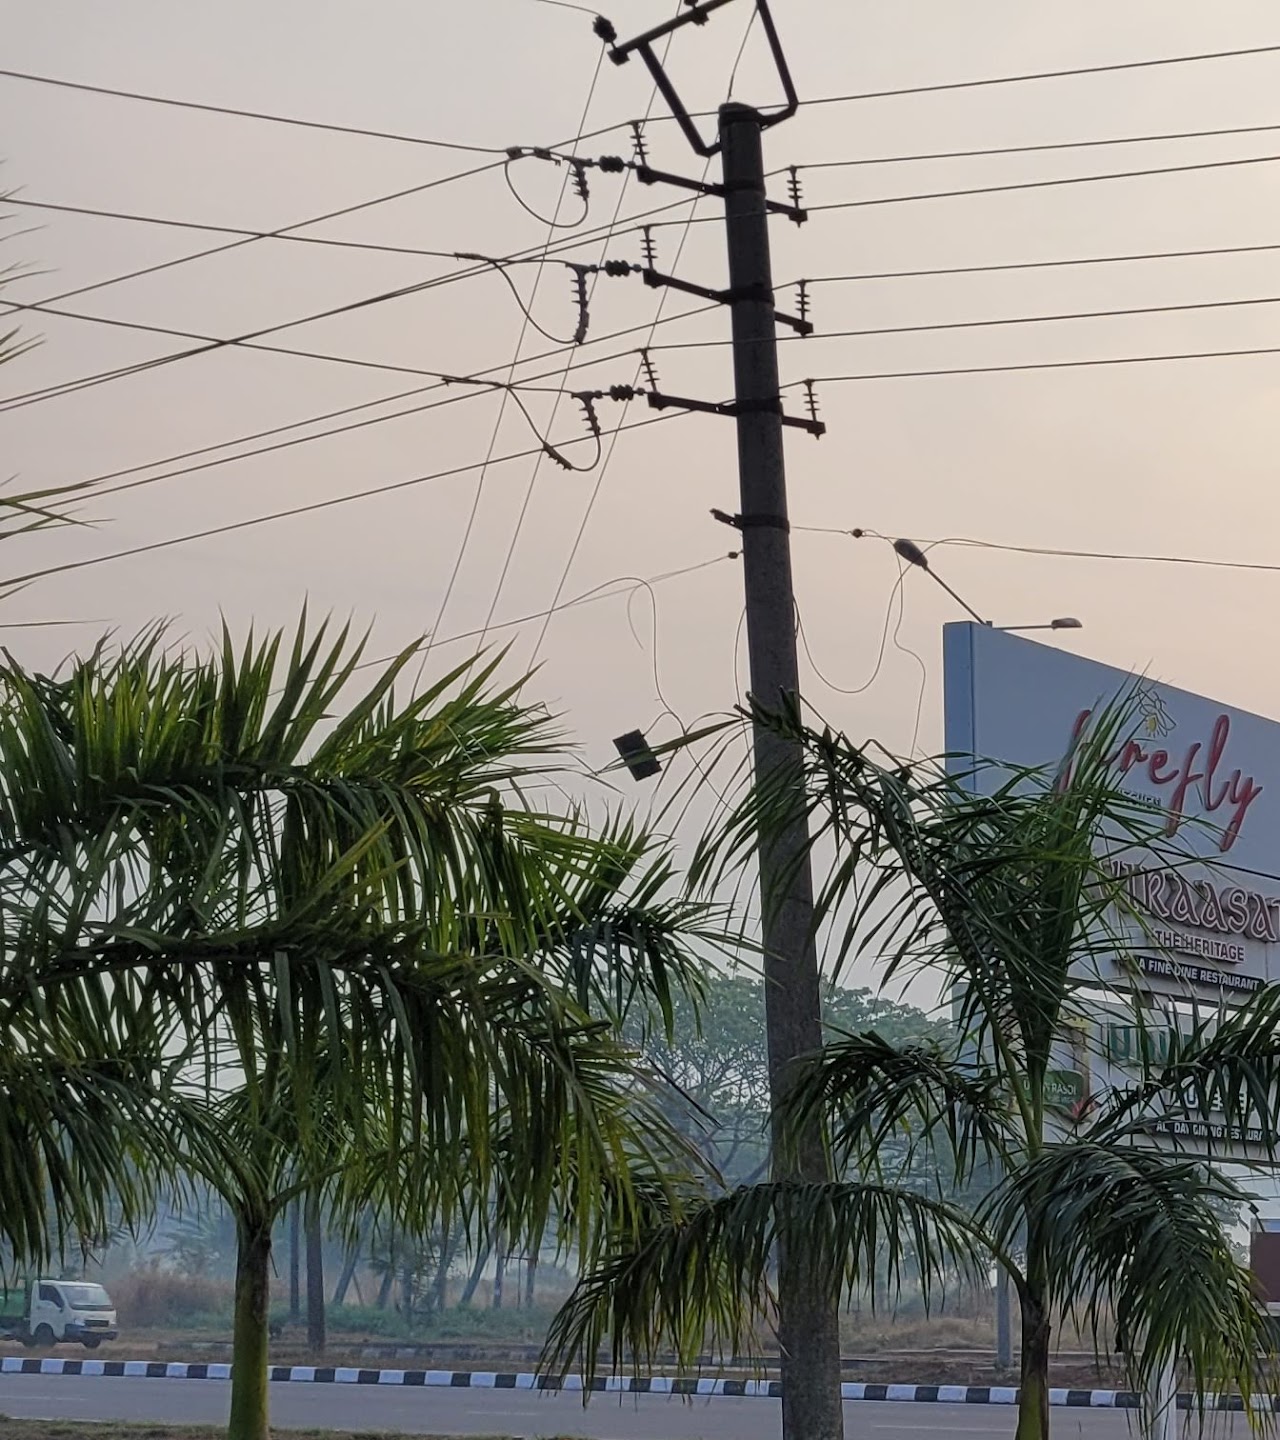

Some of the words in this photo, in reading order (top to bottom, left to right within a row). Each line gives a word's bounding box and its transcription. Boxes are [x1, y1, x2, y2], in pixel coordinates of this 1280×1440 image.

[1058, 709, 1264, 852] frefly
[1155, 930, 1182, 948] THE
[1183, 934, 1245, 962] HERITAGE
[1139, 957, 1147, 970] A
[1148, 959, 1172, 976] FINE
[1199, 970, 1260, 991] RESTAURANT
